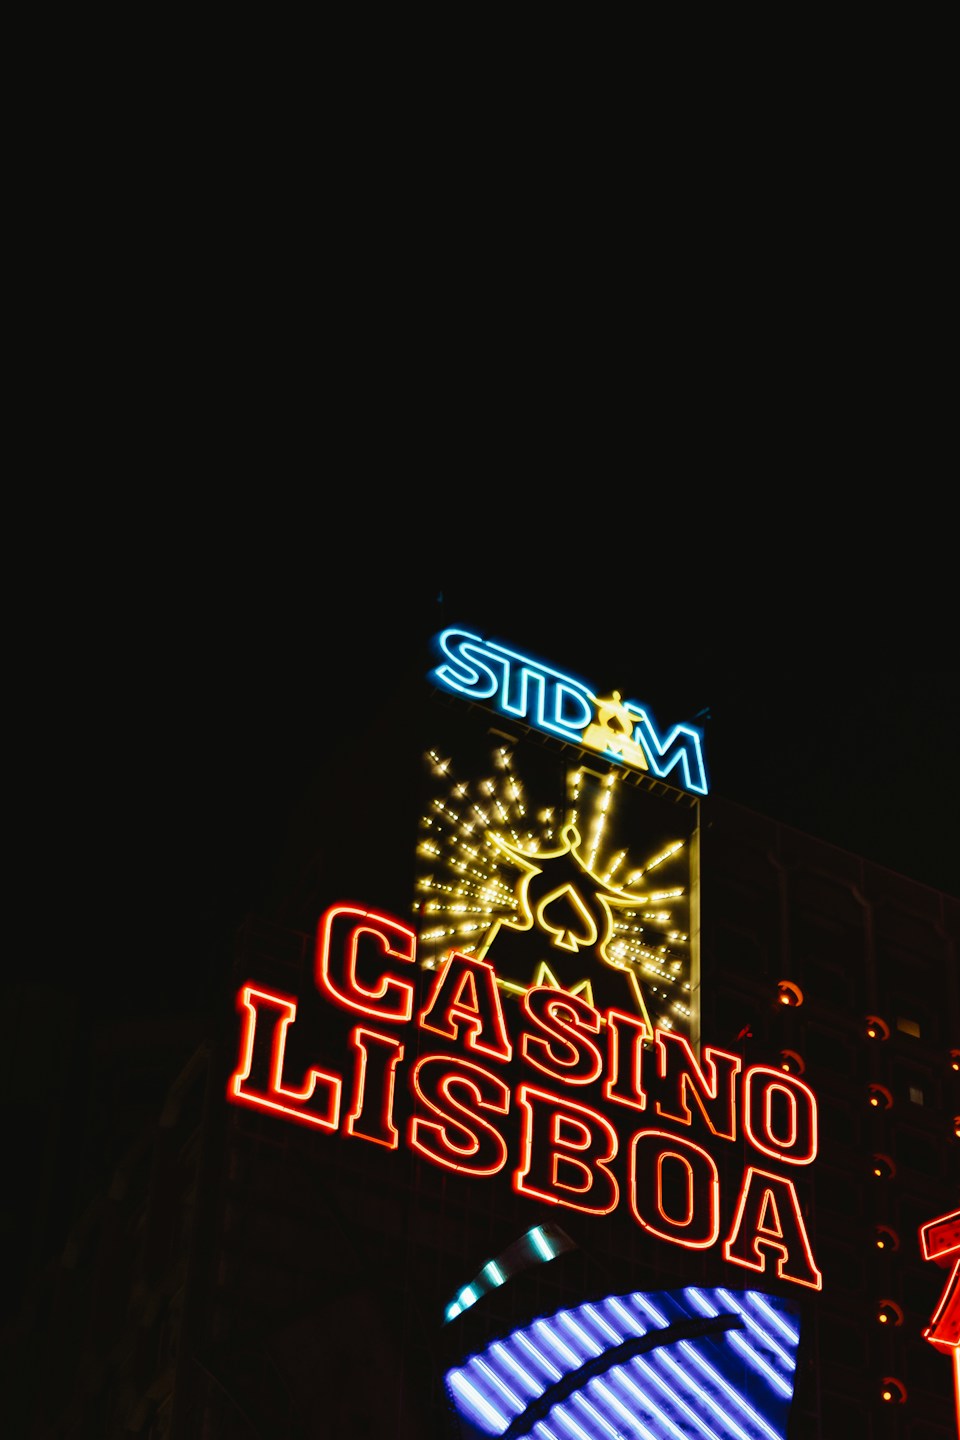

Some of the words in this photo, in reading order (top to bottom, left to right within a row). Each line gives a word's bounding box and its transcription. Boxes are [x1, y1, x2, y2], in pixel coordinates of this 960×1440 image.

[433, 627, 709, 795] STDM
[231, 986, 823, 1291] LISBOA
[317, 904, 819, 1166] CASINO
